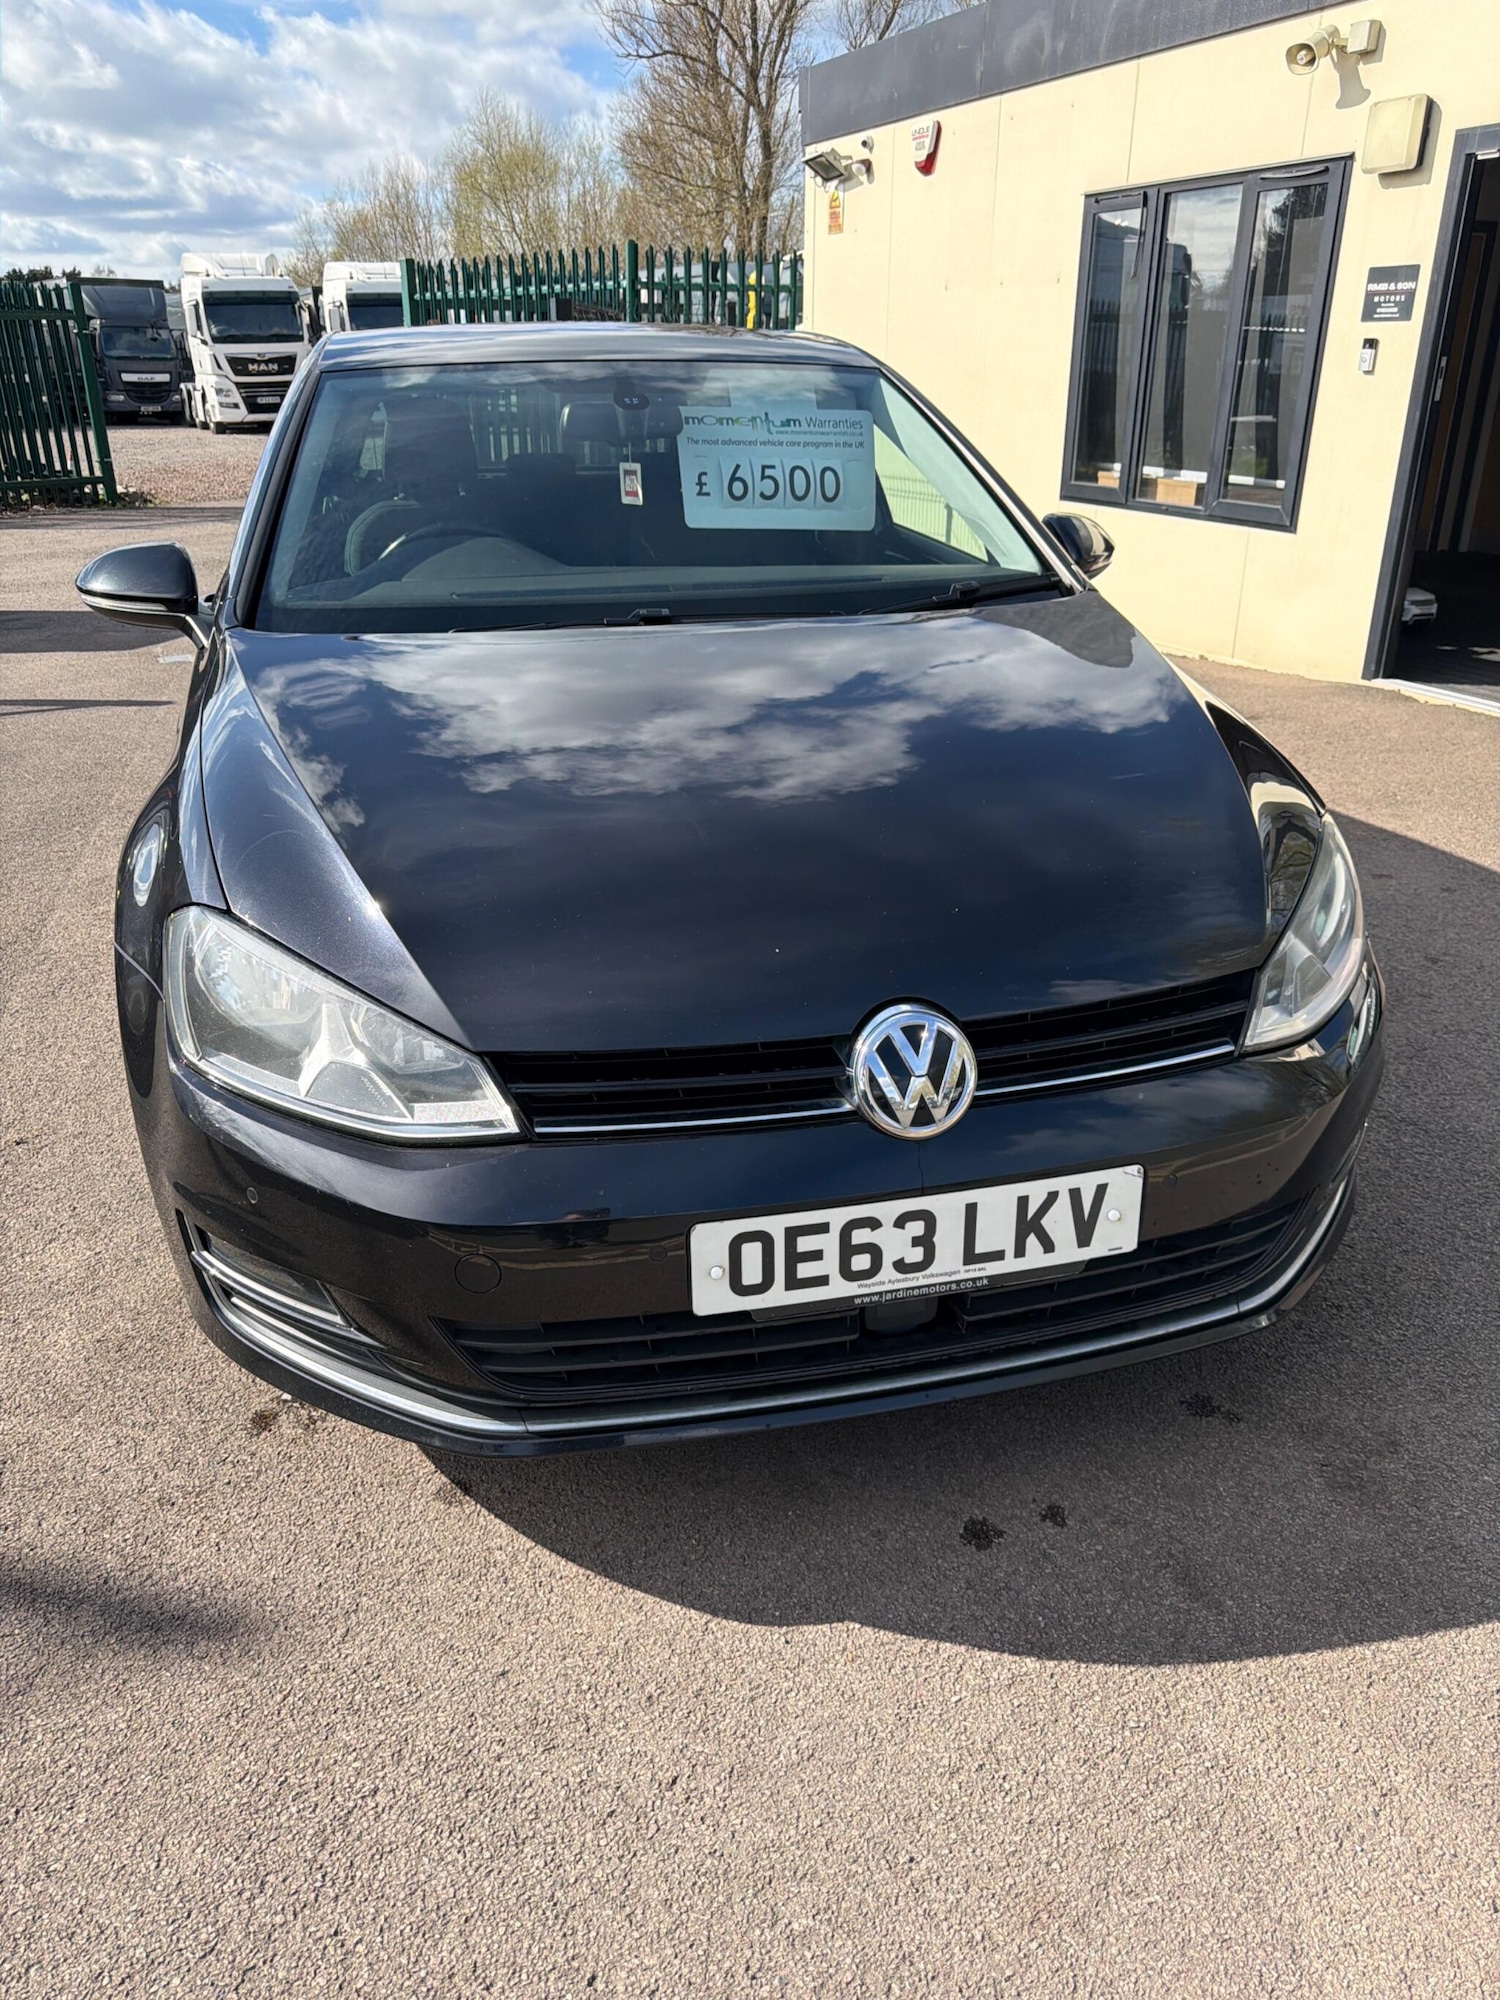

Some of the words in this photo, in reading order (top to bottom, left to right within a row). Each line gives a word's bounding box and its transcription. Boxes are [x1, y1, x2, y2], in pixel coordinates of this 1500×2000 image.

[247, 363, 279, 371] MAN
[804, 416, 864, 430] Warranties
[686, 437, 700, 446] The
[701, 438, 720, 446] most
[720, 438, 758, 446] advanced
[759, 438, 784, 447] vehicle
[802, 440, 833, 449] program
[834, 440, 841, 448] in
[842, 440, 854, 448] the
[854, 440, 865, 449] UK
[695, 471, 711, 497] £
[727, 463, 841, 503] 6500
[728, 1208, 938, 1297] OE63
[963, 1182, 1109, 1266] LKV
[857, 1279, 886, 1290] Wayside
[887, 1275, 920, 1287] Aylesbury
[921, 1269, 961, 1281] Volkswagen
[854, 1277, 989, 1304] www.jardinemotors.co.uk
